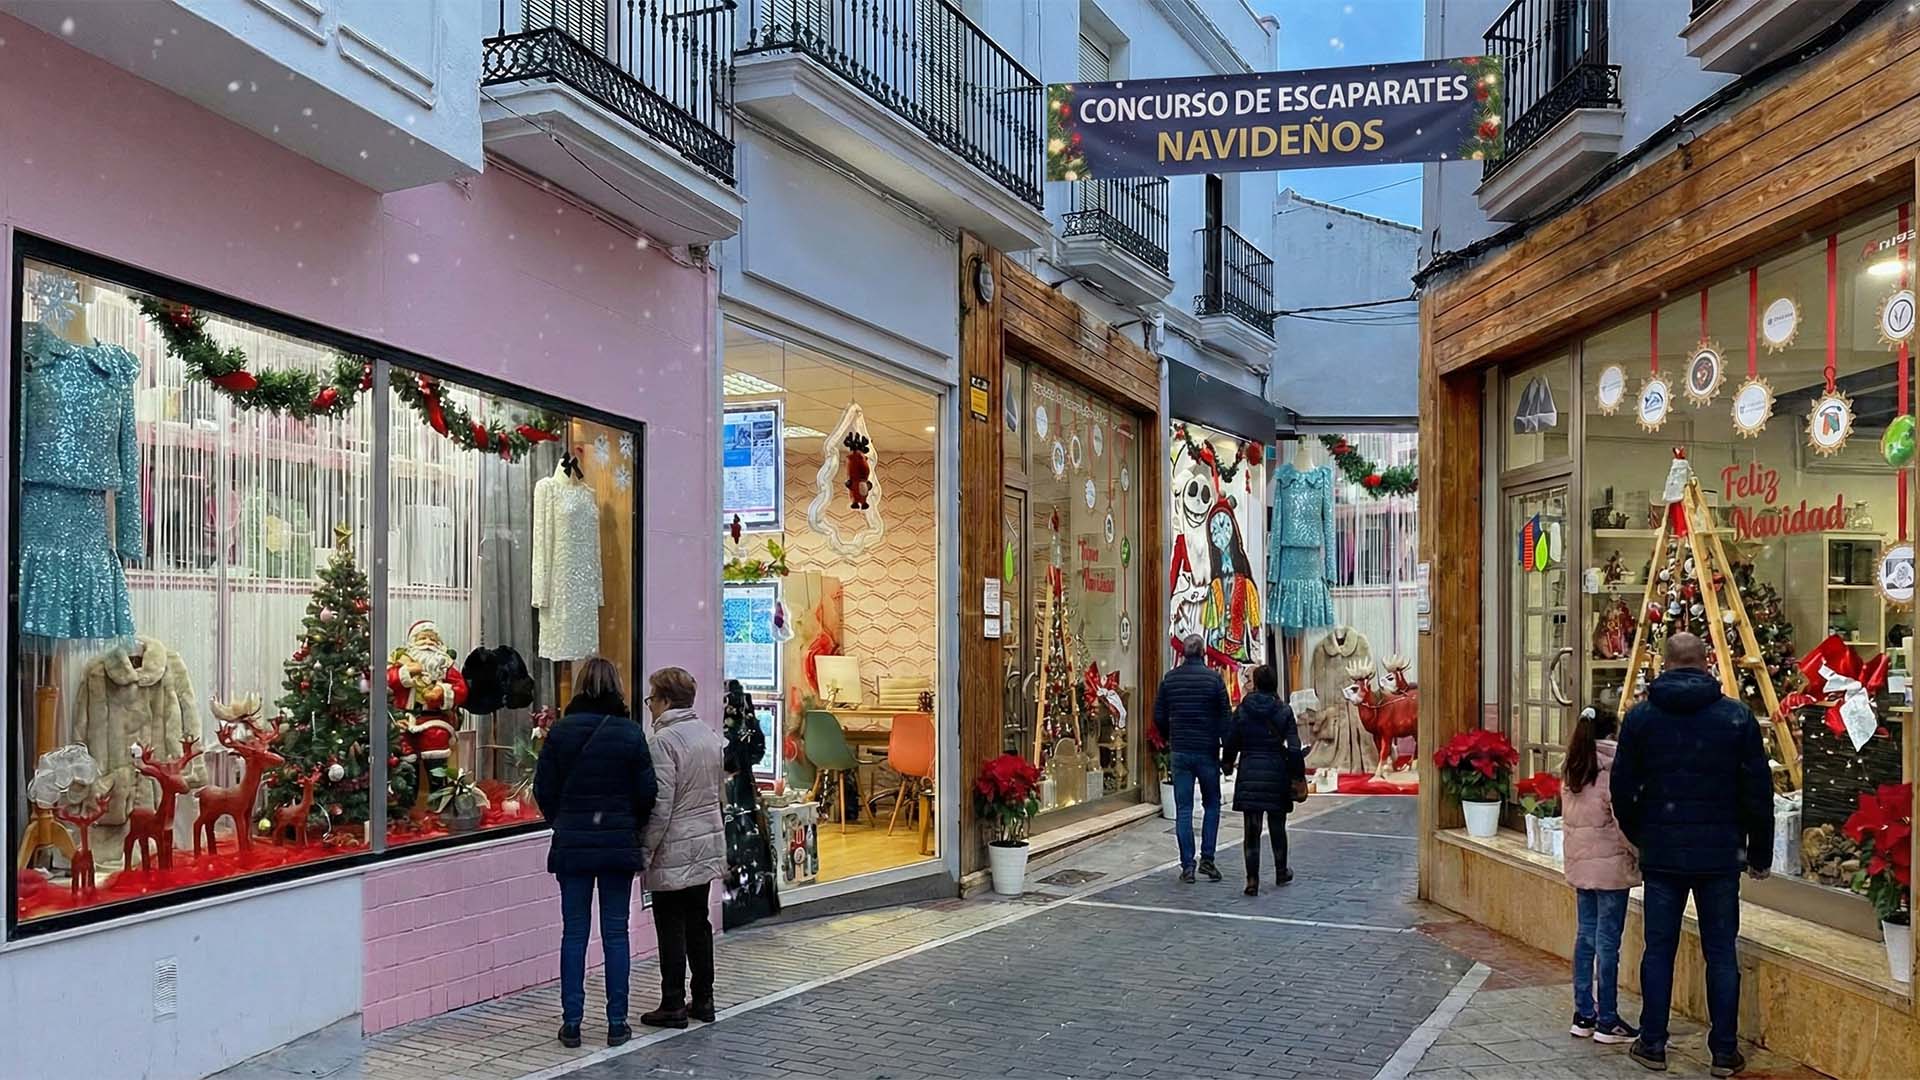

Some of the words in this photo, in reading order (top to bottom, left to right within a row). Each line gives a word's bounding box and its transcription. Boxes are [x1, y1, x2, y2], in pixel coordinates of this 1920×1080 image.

[1079, 91, 1228, 124] CONCURSO
[1235, 88, 1271, 115] DE
[1278, 75, 1468, 112] ESCAPARATES
[1158, 115, 1385, 162] NAVIDEÑOS
[1721, 463, 1780, 504] Feliz
[1729, 493, 1847, 543] Navidad
